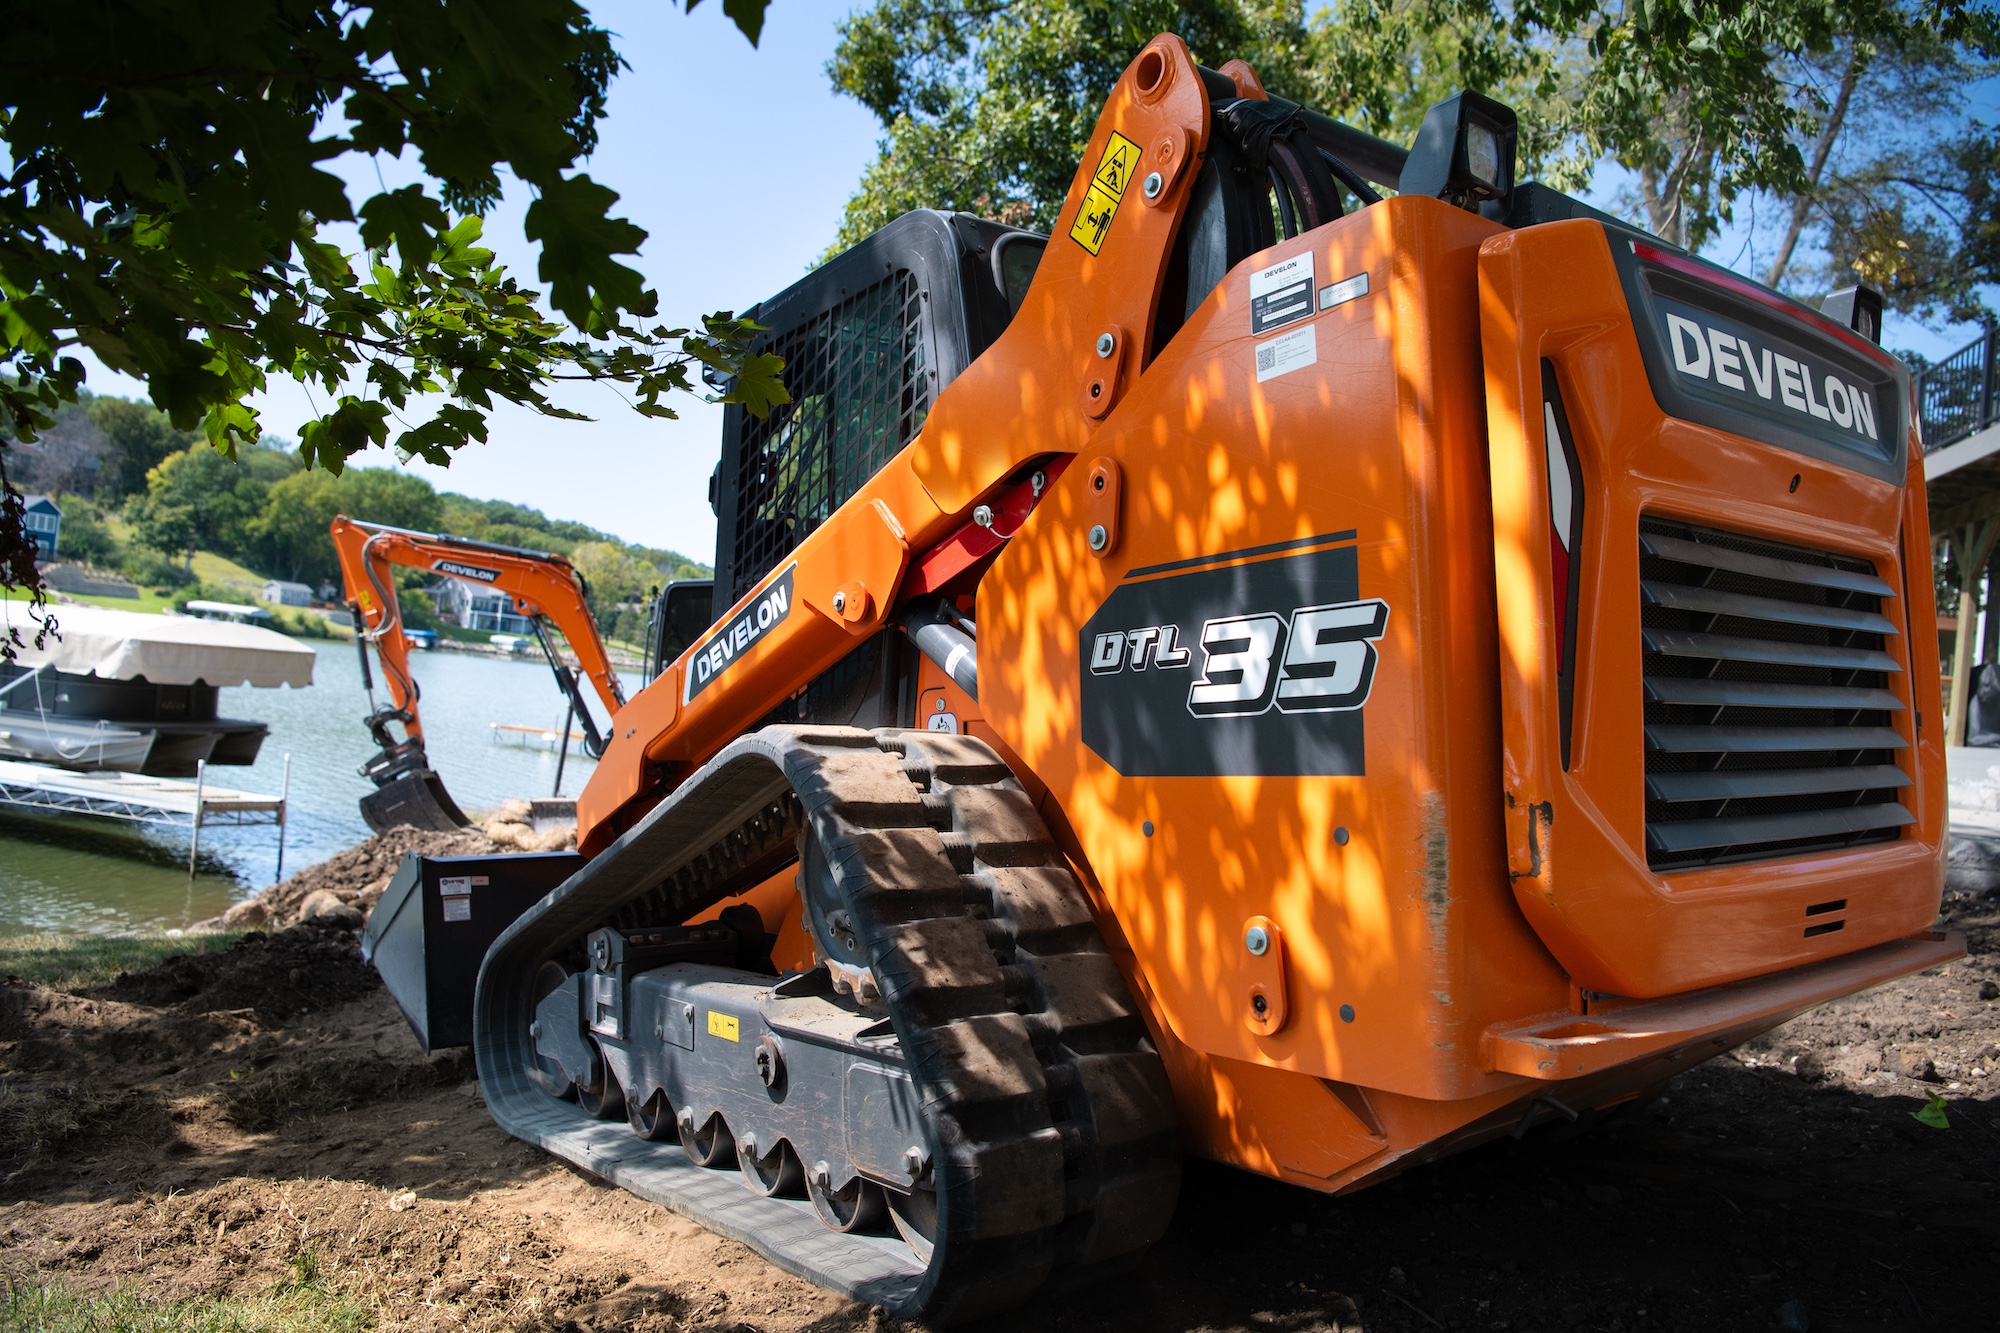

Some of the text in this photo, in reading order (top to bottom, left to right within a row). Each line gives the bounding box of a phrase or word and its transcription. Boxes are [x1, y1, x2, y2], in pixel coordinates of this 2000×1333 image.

[1264, 261, 1298, 279] DEVELON
[1666, 312, 1879, 441] DEVELON
[441, 562, 495, 582] DEVELON
[696, 584, 789, 685] DEVELON
[1089, 597, 1391, 719] DTL 35
